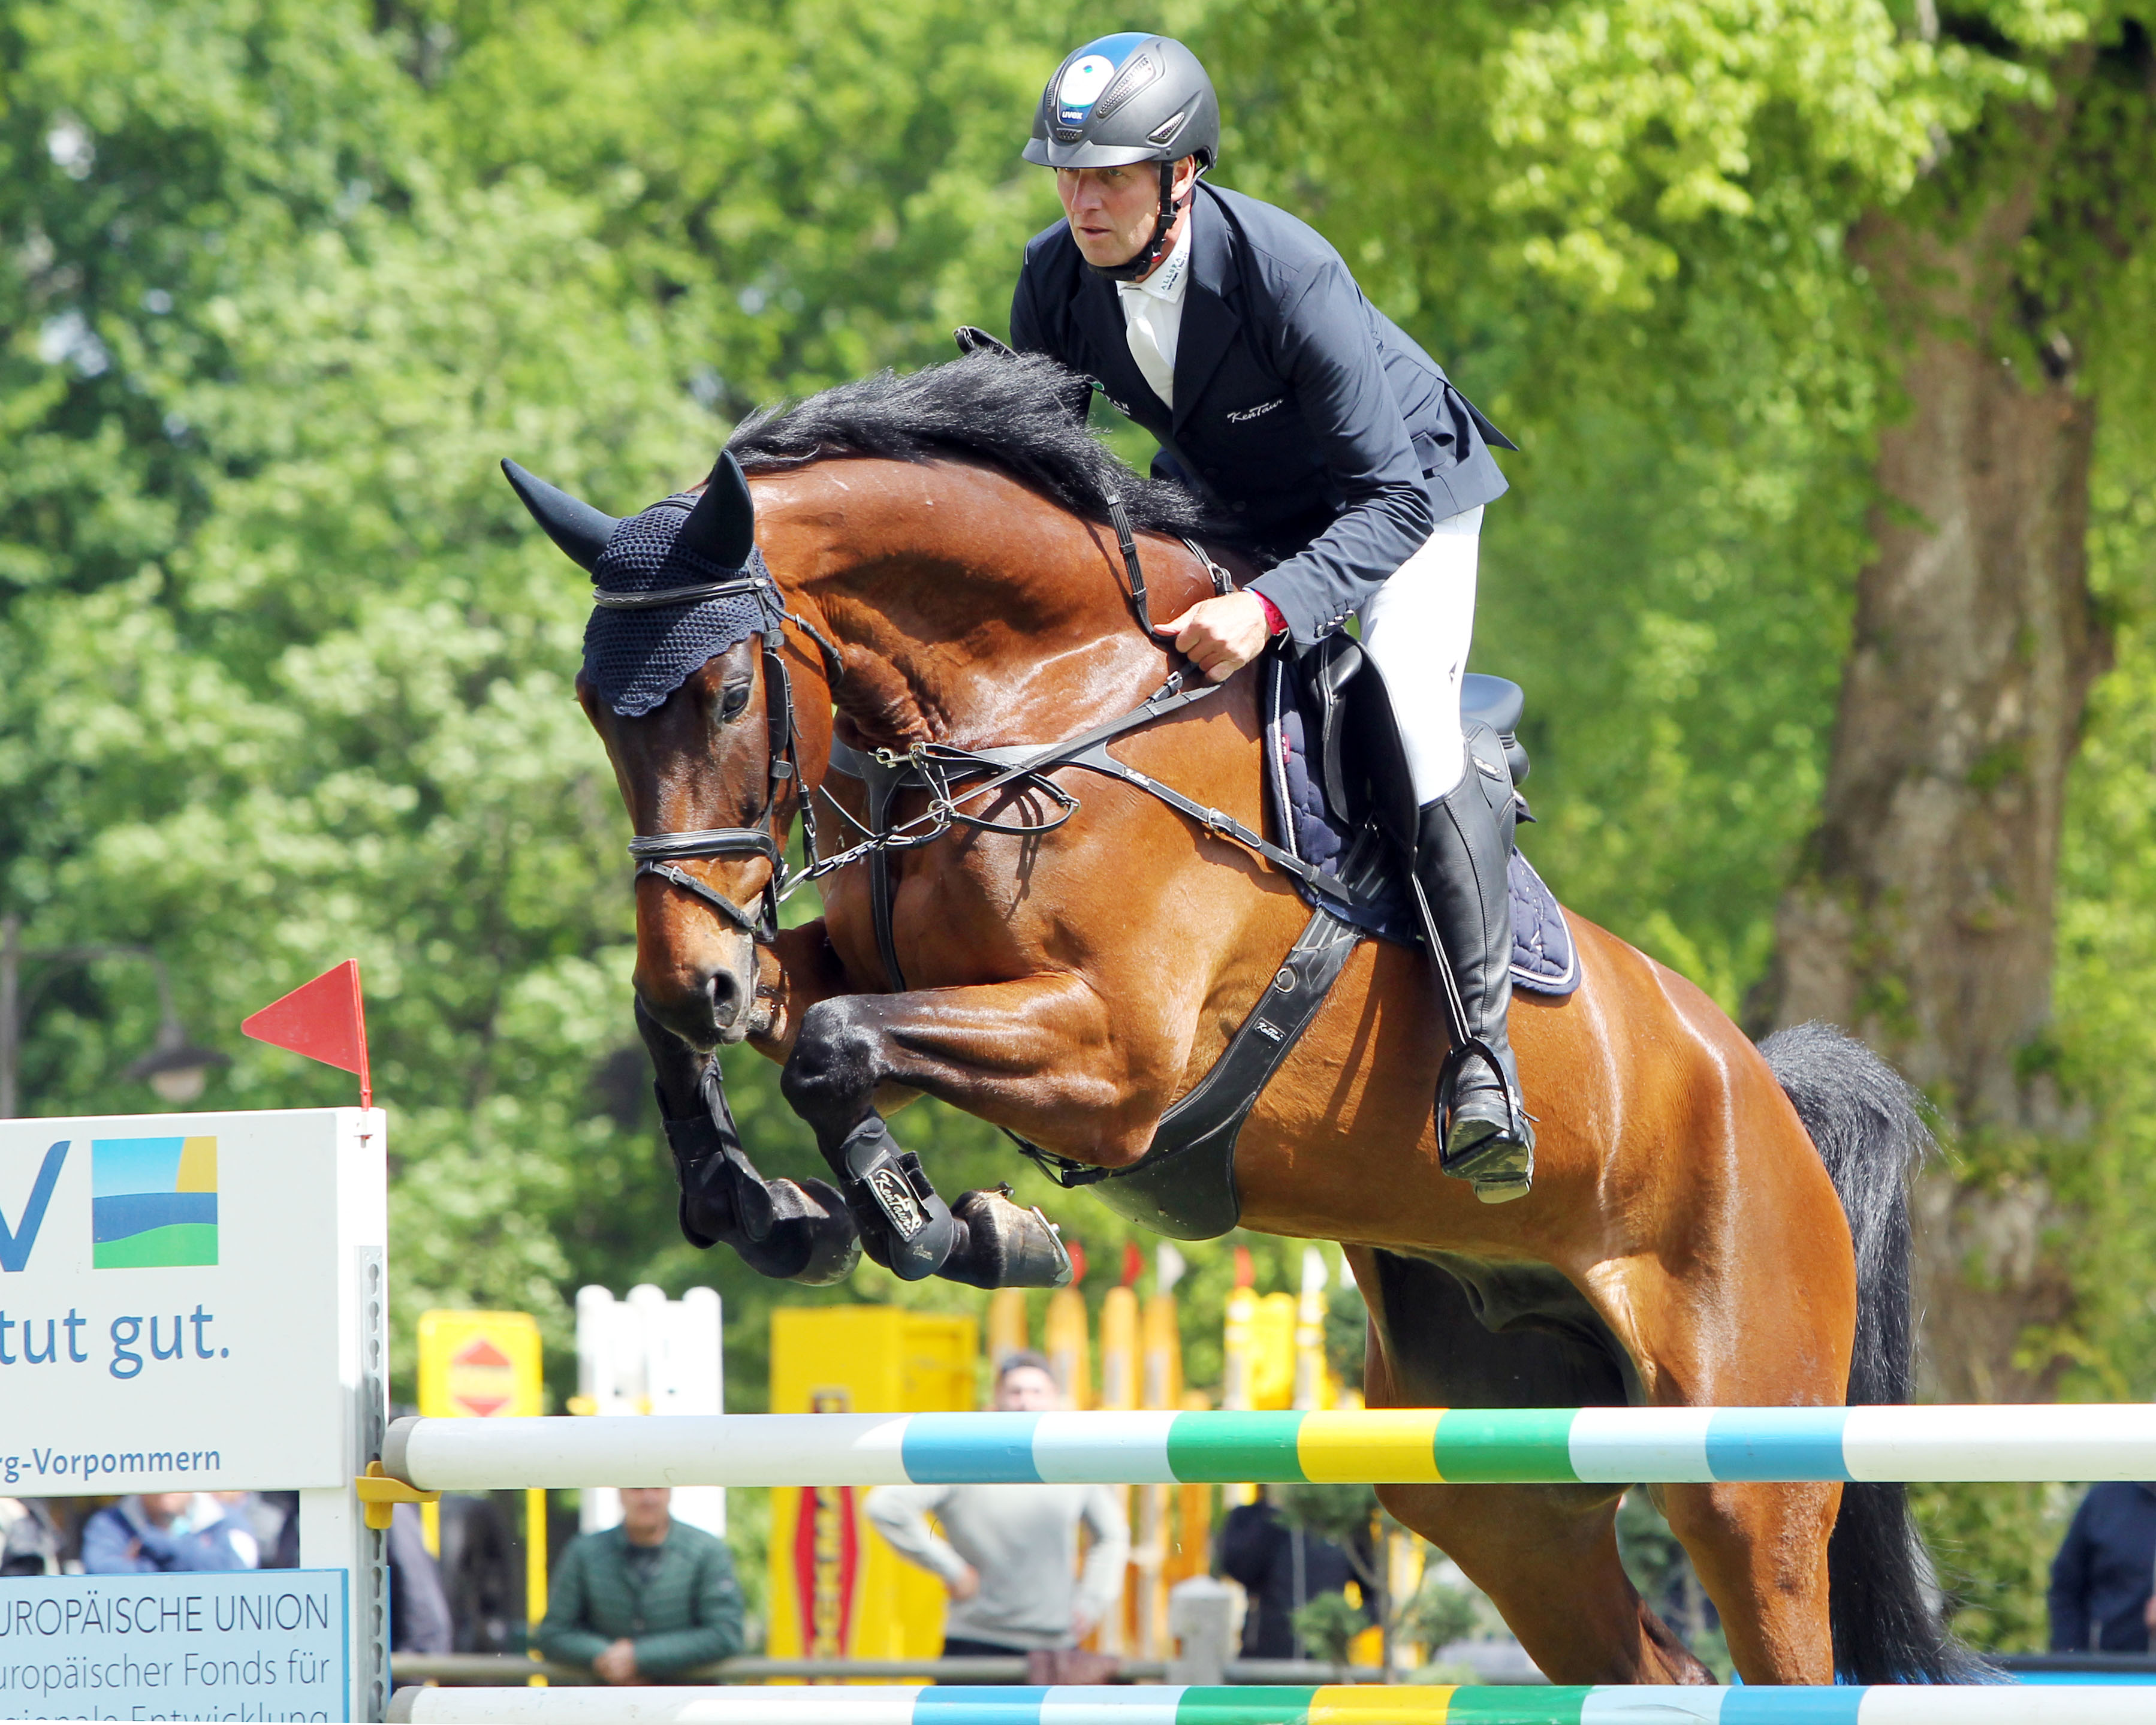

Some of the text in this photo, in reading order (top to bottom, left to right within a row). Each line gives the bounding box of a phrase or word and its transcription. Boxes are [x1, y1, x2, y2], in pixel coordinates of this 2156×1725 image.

[1062, 111, 1083, 119] uvex
[0, 1304, 229, 1379] tut gut.
[0, 1448, 220, 1483] g-Vorpommern
[216, 1594, 328, 1631] UNION
[185, 1651, 277, 1685] Fonds
[288, 1649, 330, 1684] für
